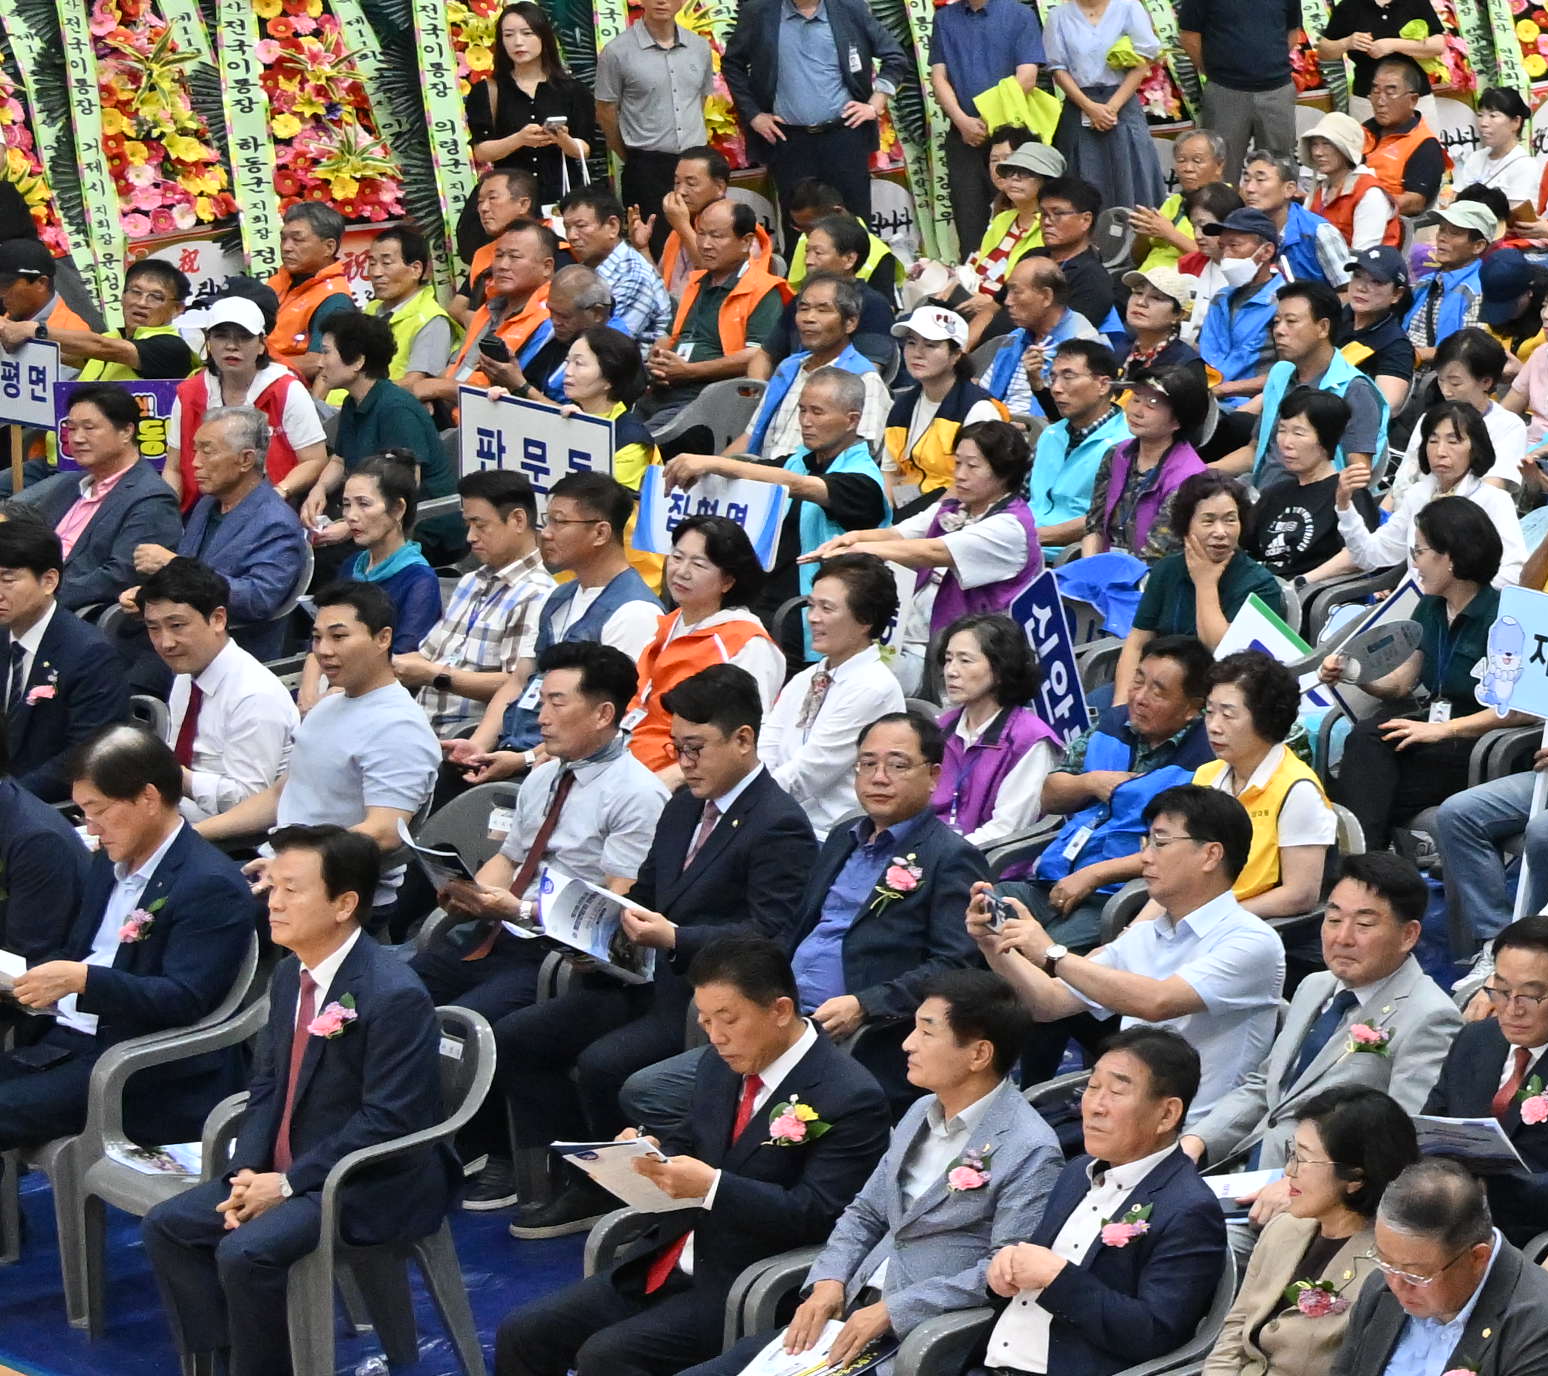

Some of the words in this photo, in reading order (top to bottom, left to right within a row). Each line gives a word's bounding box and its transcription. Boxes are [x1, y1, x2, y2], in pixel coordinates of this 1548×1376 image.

[79, 138, 106, 198] 거제시
[238, 135, 266, 195] 하동군
[434, 119, 466, 174] 의령군
[178, 248, 201, 273] 祝
